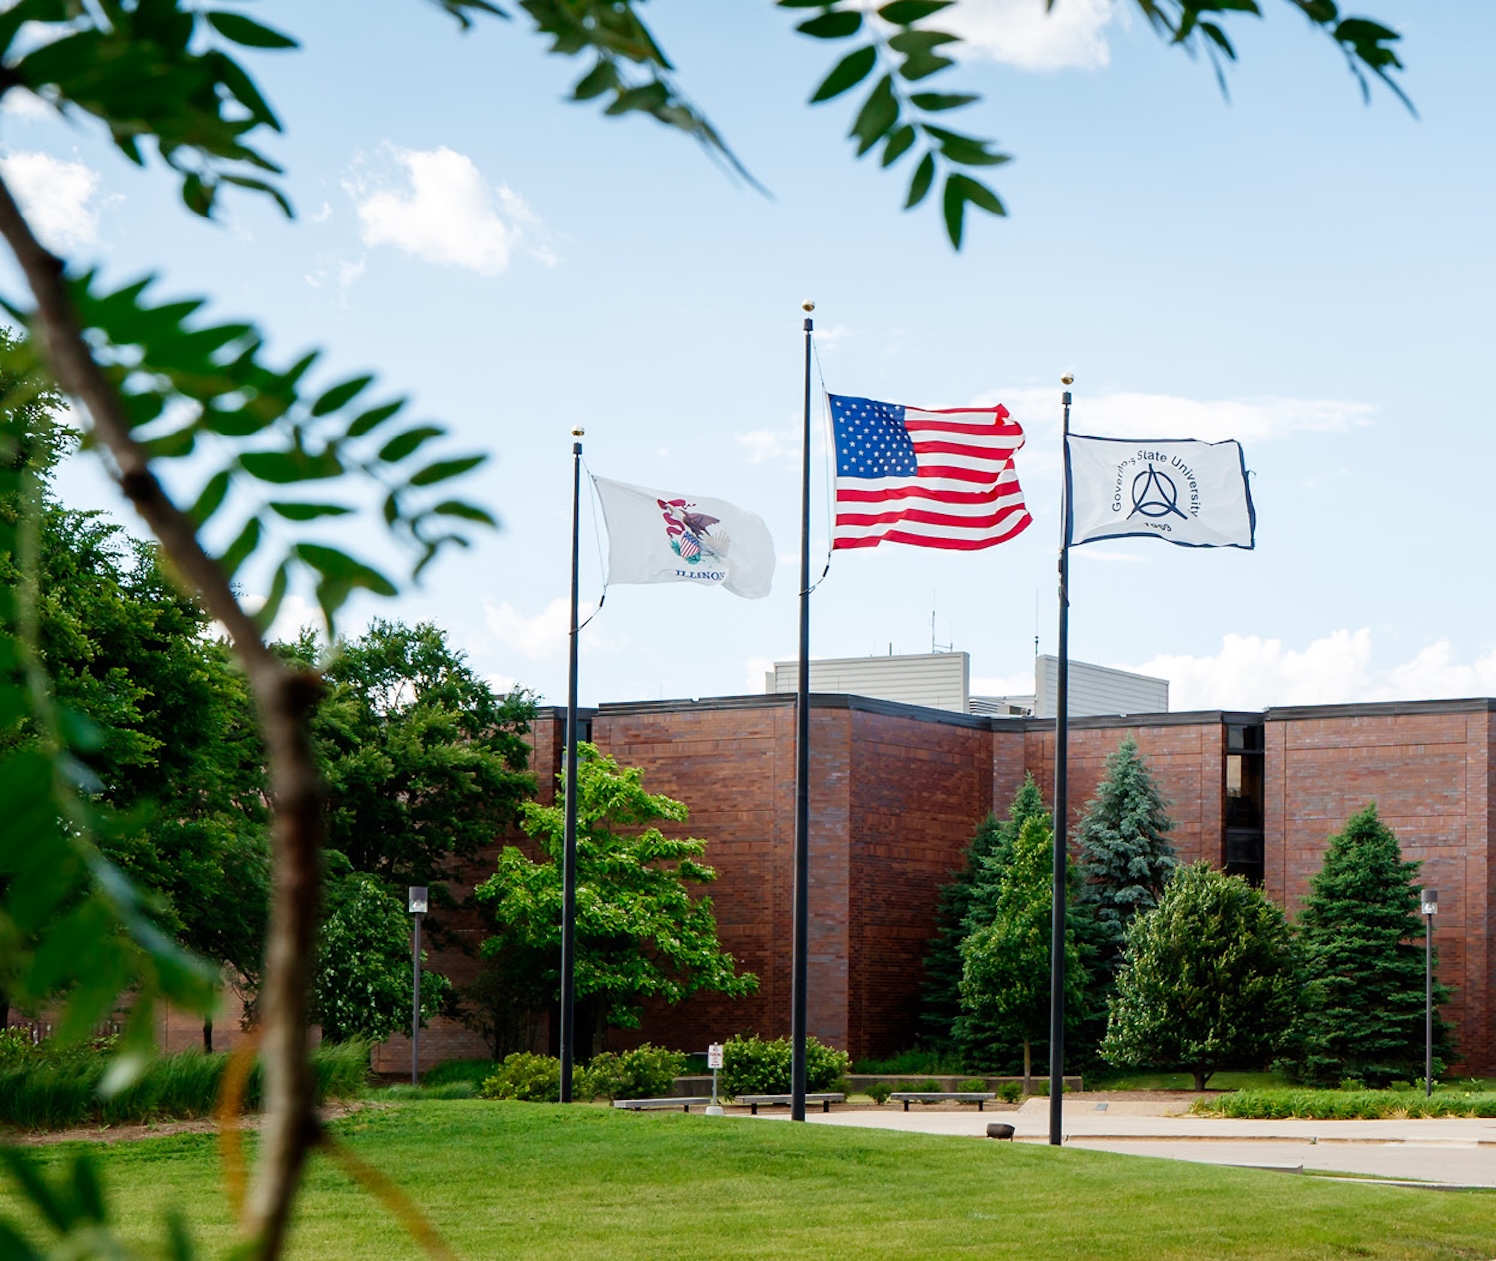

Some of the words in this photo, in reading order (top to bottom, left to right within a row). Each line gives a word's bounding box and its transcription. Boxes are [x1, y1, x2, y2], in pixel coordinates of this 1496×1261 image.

[1112, 456, 1136, 512] Governos
[1137, 450, 1167, 462] State
[1171, 456, 1201, 518] University
